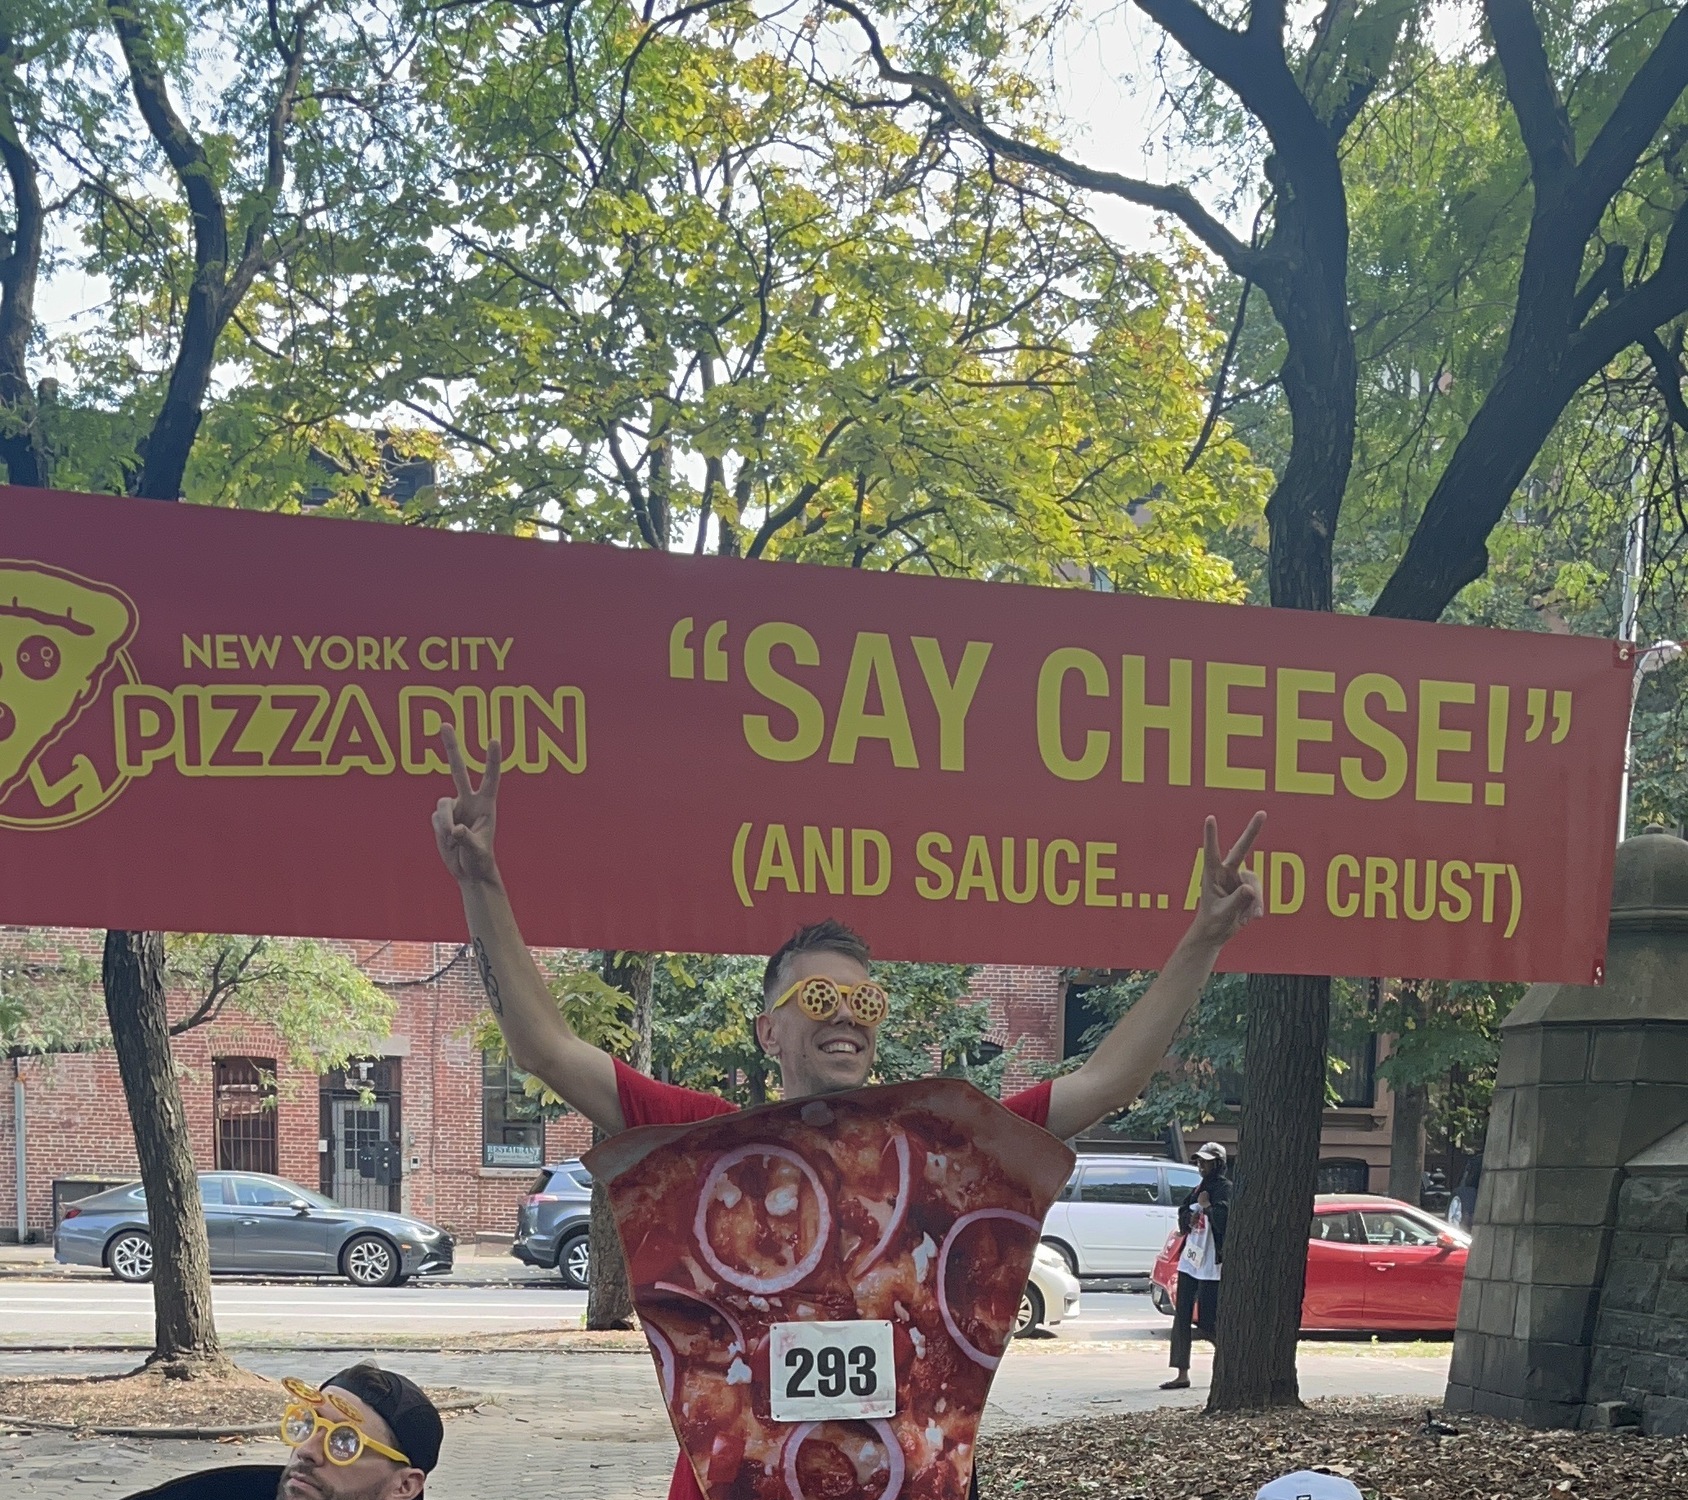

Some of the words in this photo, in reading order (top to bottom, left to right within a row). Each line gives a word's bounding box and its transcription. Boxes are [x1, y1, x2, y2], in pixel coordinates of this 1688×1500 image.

[182, 633, 282, 670] NEW
[292, 635, 409, 671] YORK
[418, 636, 514, 671] CITY
[113, 684, 396, 776] PIZZA
[399, 684, 588, 775] RUN
[669, 616, 994, 772] “SAY
[1036, 646, 1573, 806] CHEESE!”
[731, 822, 893, 908] (AND
[914, 831, 1169, 909] SAUCE...
[1325, 853, 1523, 939] CRUST)
[785, 1345, 878, 1399] 293
